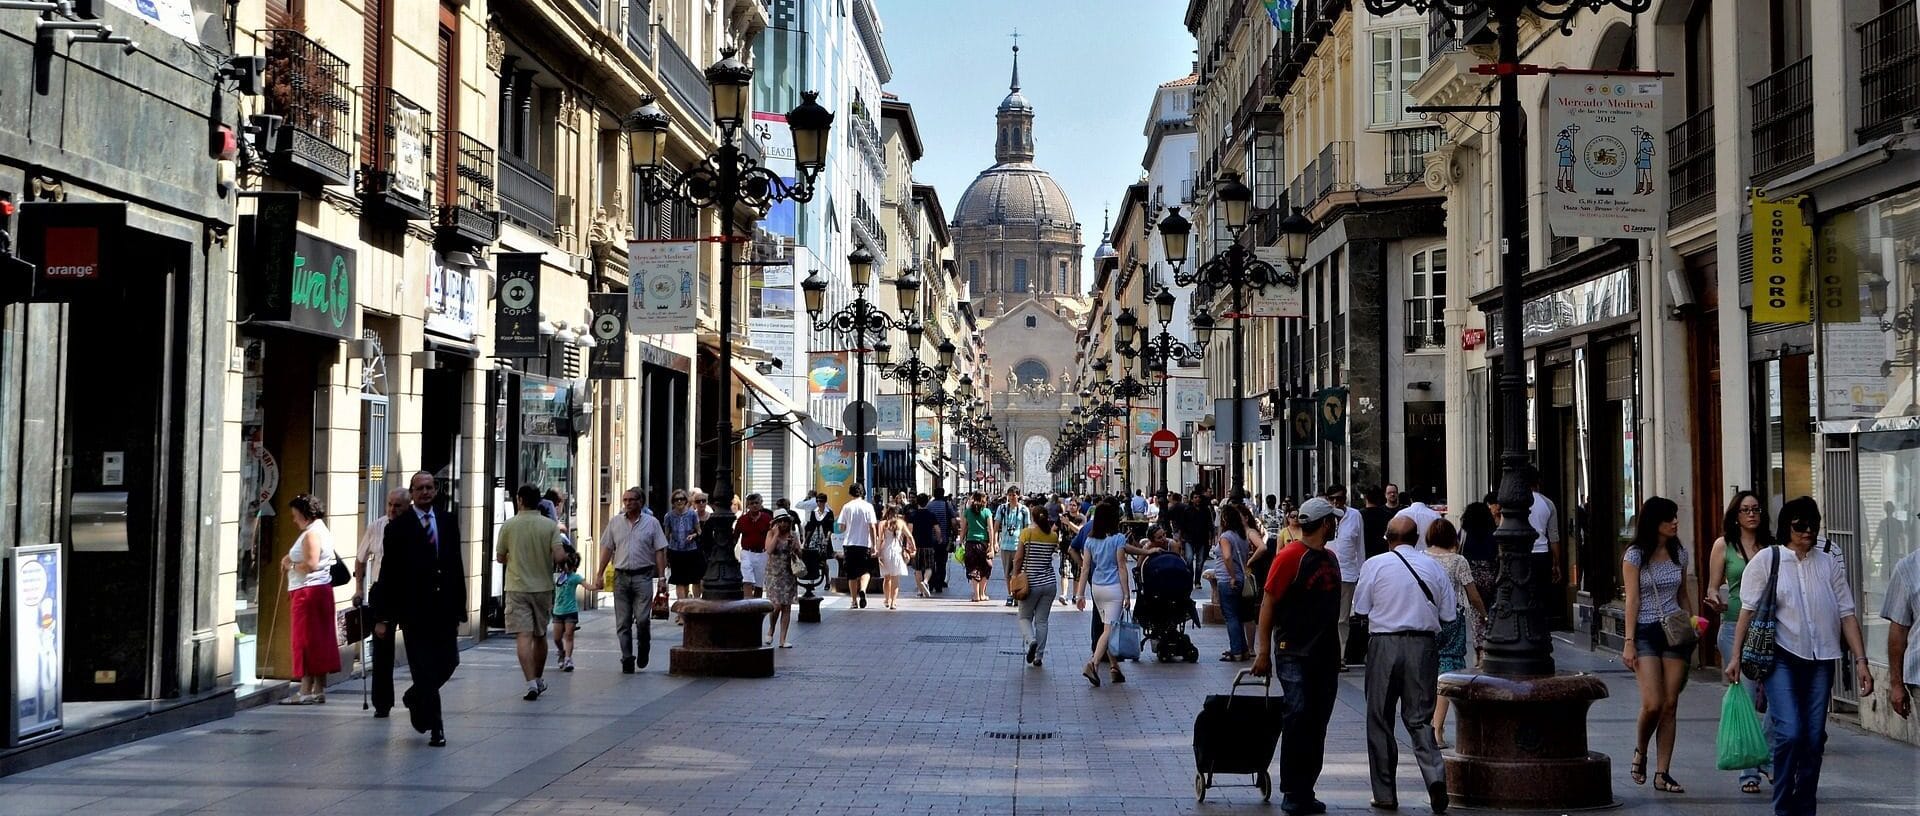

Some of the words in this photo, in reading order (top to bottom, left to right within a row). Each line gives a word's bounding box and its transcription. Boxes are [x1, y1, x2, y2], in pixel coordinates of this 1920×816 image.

[1558, 97, 1602, 107] Mercado
[1608, 98, 1654, 108] Medieval
[1771, 210, 1784, 264] COMPRO
[47, 266, 93, 278] orange
[292, 251, 329, 313] tura
[510, 289, 525, 297] ON
[1769, 275, 1786, 308] ORO
[503, 306, 532, 316] COPAS
[1421, 413, 1446, 424] CAFF
